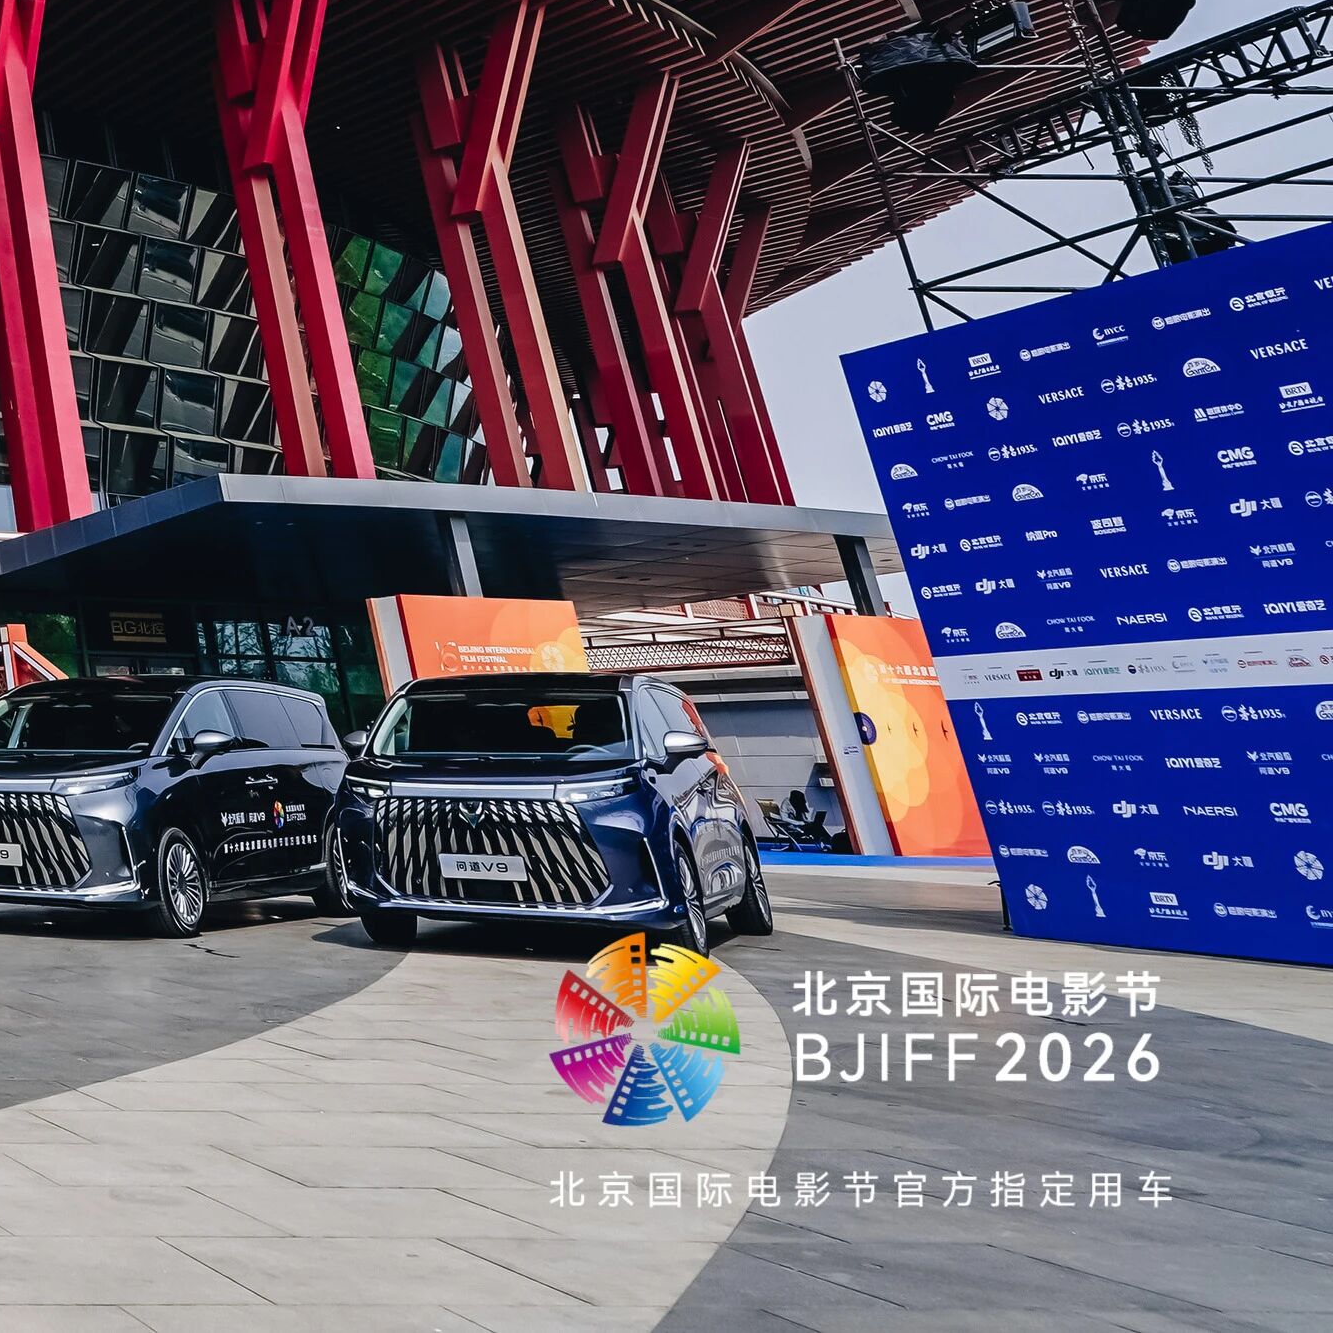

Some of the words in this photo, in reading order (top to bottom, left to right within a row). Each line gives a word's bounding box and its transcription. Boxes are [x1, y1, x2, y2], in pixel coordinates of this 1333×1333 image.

[1250, 339, 1308, 359] VERSACE
[1038, 386, 1084, 404] VERSACE
[1284, 385, 1307, 396] BRTV
[926, 411, 953, 426] CMG
[1217, 446, 1254, 463] CMG
[1100, 564, 1149, 578] VERSACE
[1116, 613, 1167, 625] NAERSI
[1149, 708, 1202, 721] VERSACE
[1183, 805, 1238, 816] NAERSI
[1270, 802, 1309, 817] CMG
[456, 861, 508, 872] 问道V9
